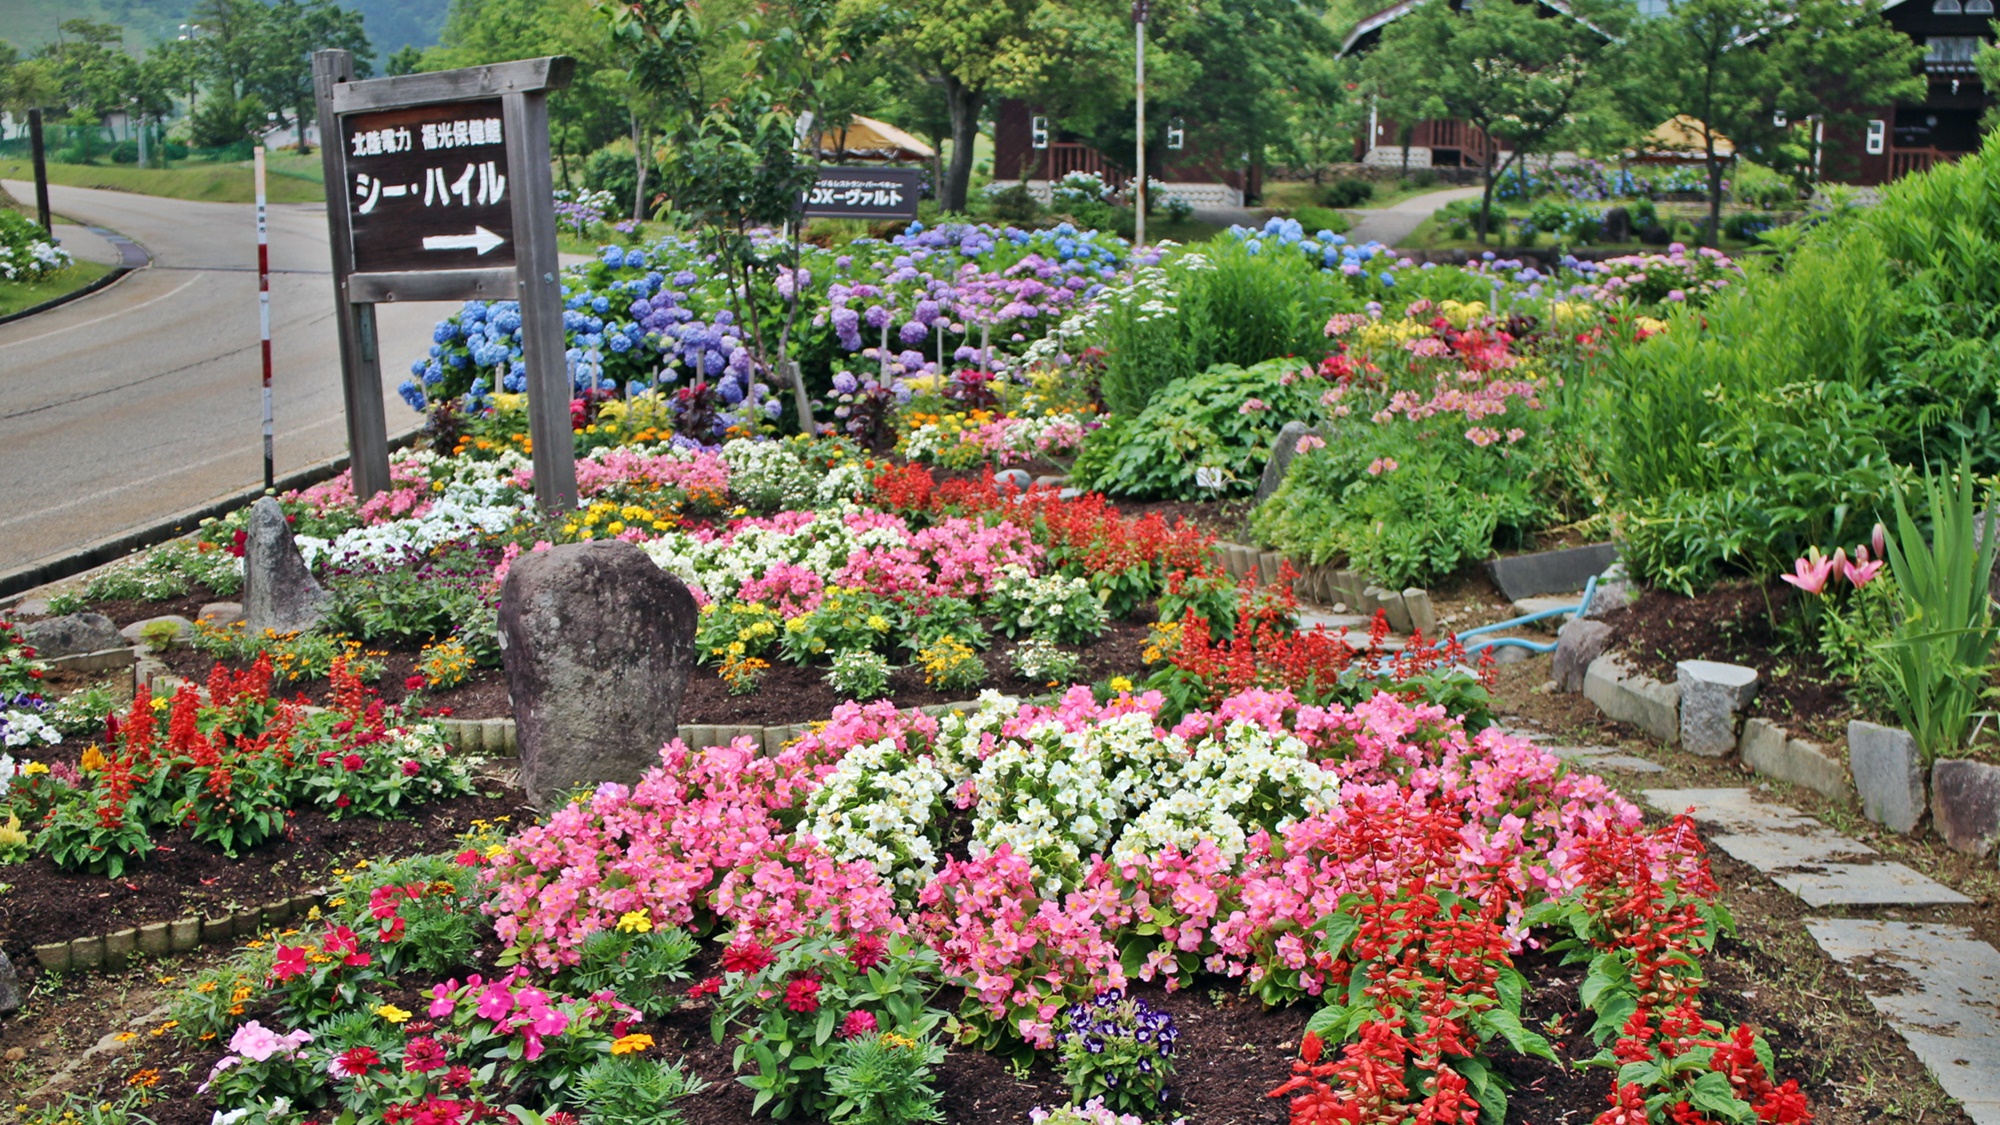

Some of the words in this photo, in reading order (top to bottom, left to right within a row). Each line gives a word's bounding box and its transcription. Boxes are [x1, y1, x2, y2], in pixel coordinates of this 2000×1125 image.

[351, 127, 412, 156] 北陸電力
[356, 161, 506, 214] シー・ハイル
